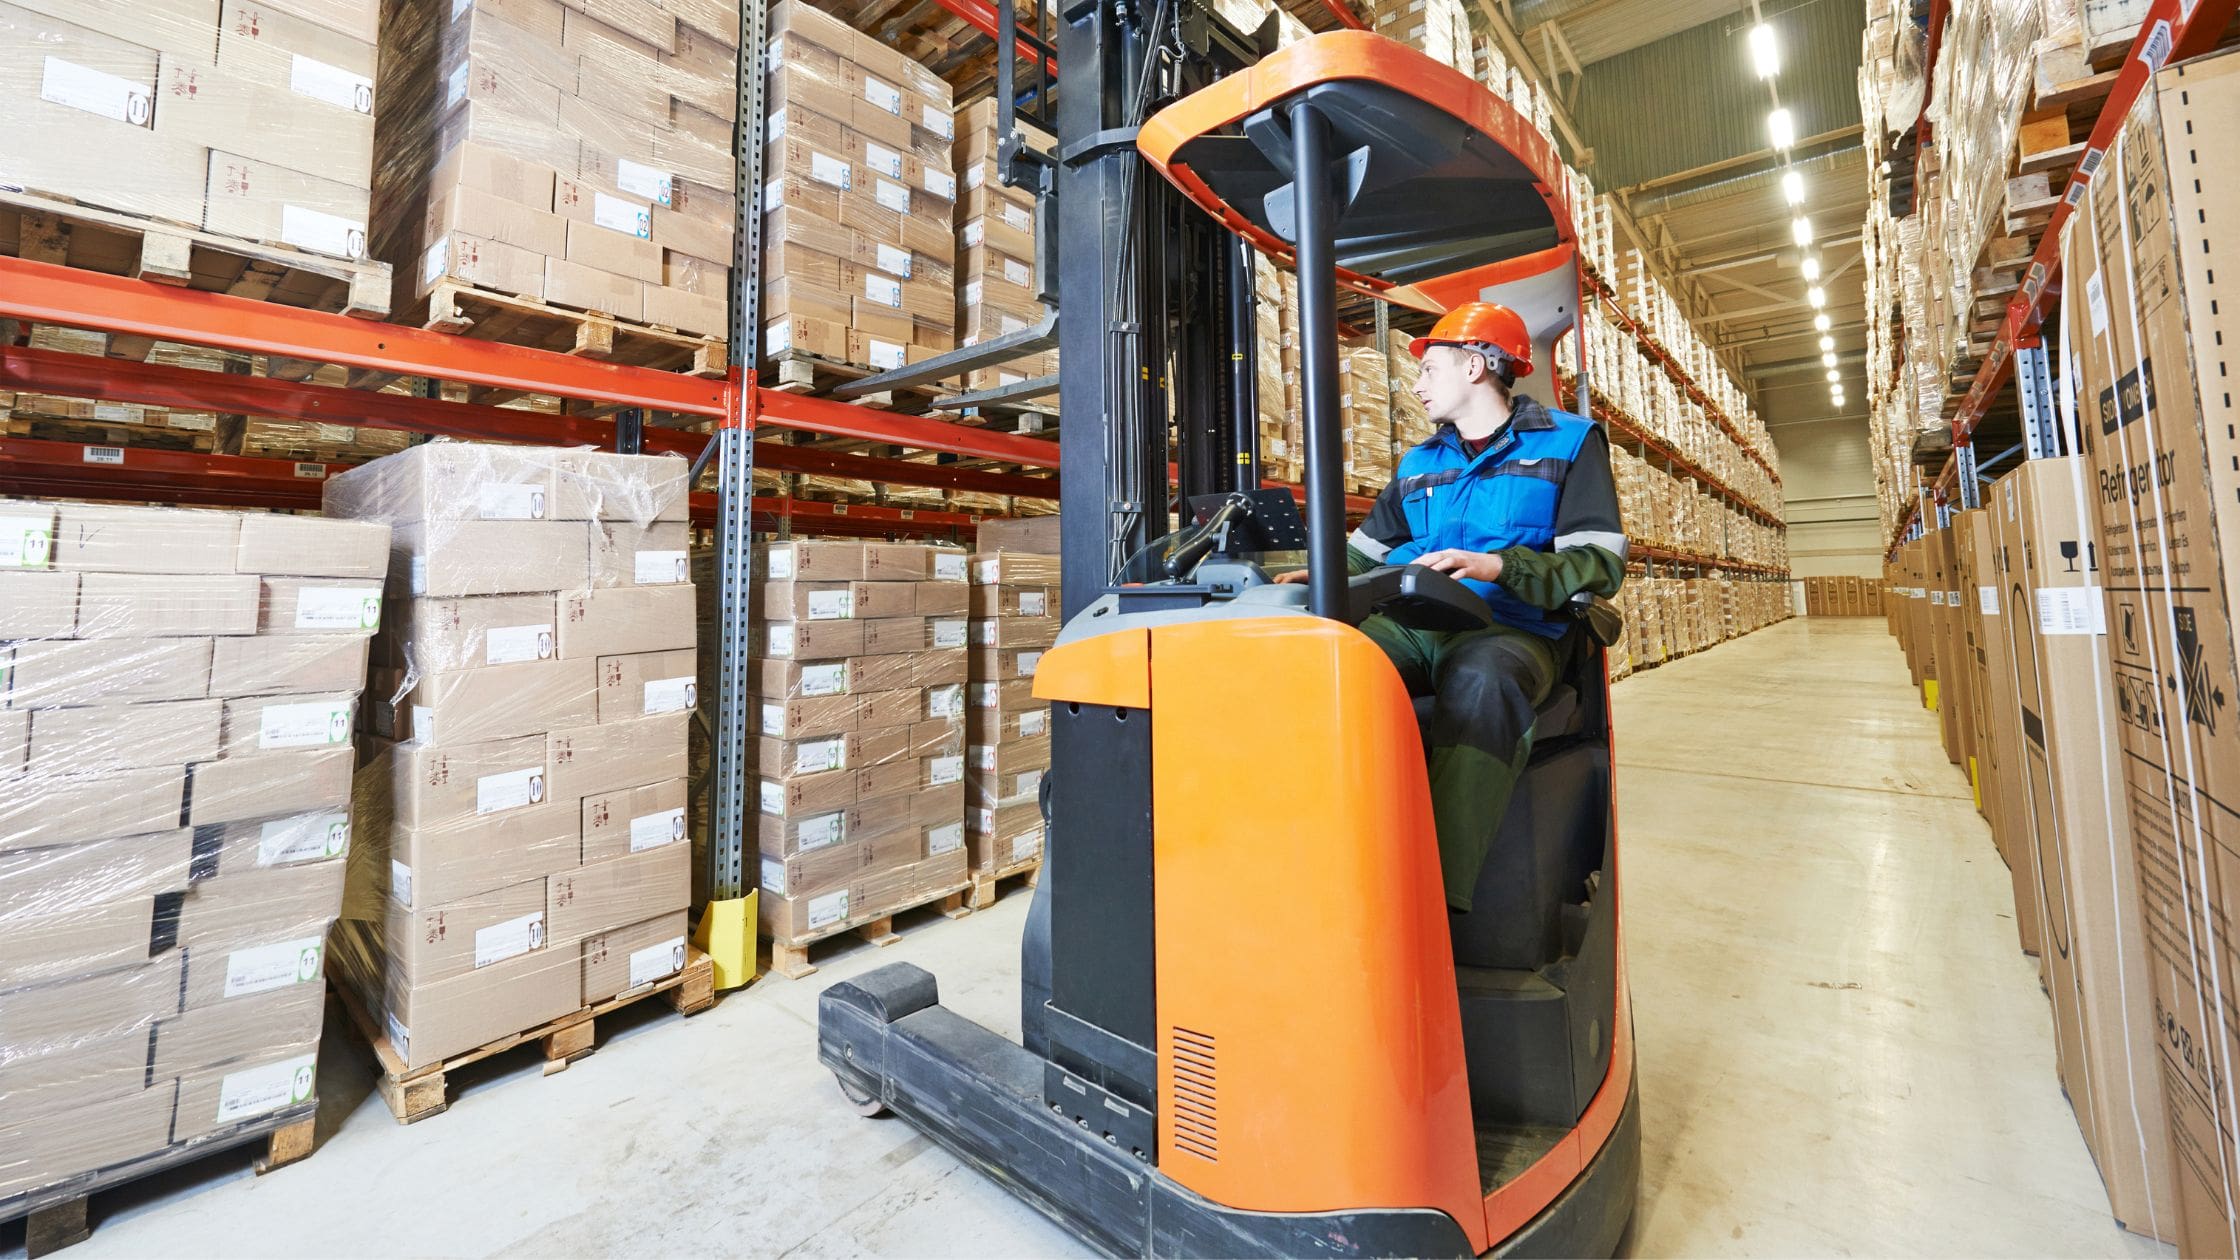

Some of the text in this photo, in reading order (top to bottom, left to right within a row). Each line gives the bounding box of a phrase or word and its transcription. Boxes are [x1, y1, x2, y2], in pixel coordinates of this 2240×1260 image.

[359, 92, 370, 107] 11
[133, 100, 147, 118] 11
[352, 237, 362, 251] 11
[2100, 448, 2175, 506] Refrgertor
[534, 498, 544, 512] 10
[31, 539, 44, 549] 11
[678, 564, 686, 576] 10
[367, 606, 377, 614] 11
[541, 638, 551, 652] 10
[688, 689, 696, 702] 10
[335, 719, 345, 727] 11
[533, 781, 542, 796] 10
[676, 822, 685, 835] 10
[532, 927, 542, 943] 10
[304, 957, 315, 966] 11
[676, 951, 684, 964] 10
[299, 1074, 310, 1085] 11
